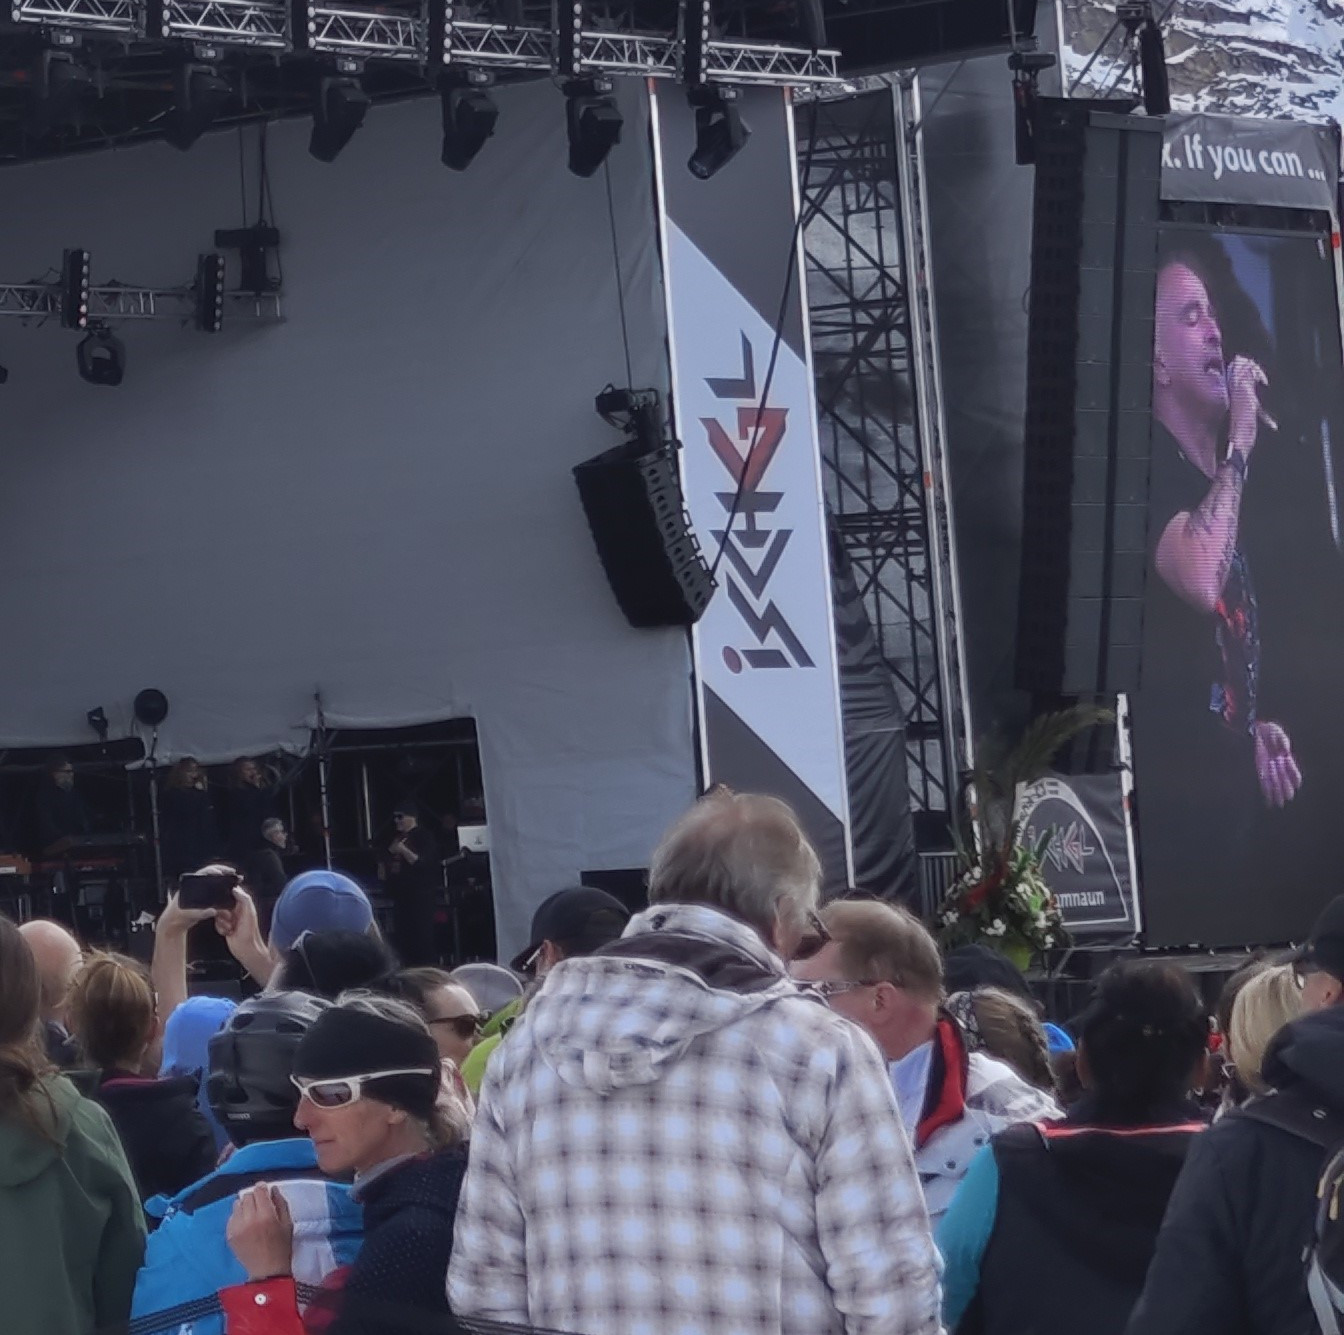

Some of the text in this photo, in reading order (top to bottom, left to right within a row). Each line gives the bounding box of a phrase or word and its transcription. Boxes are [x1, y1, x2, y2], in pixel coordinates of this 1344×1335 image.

[1184, 133, 1205, 169] If
[1207, 144, 1257, 181] you
[1258, 150, 1304, 177] can
